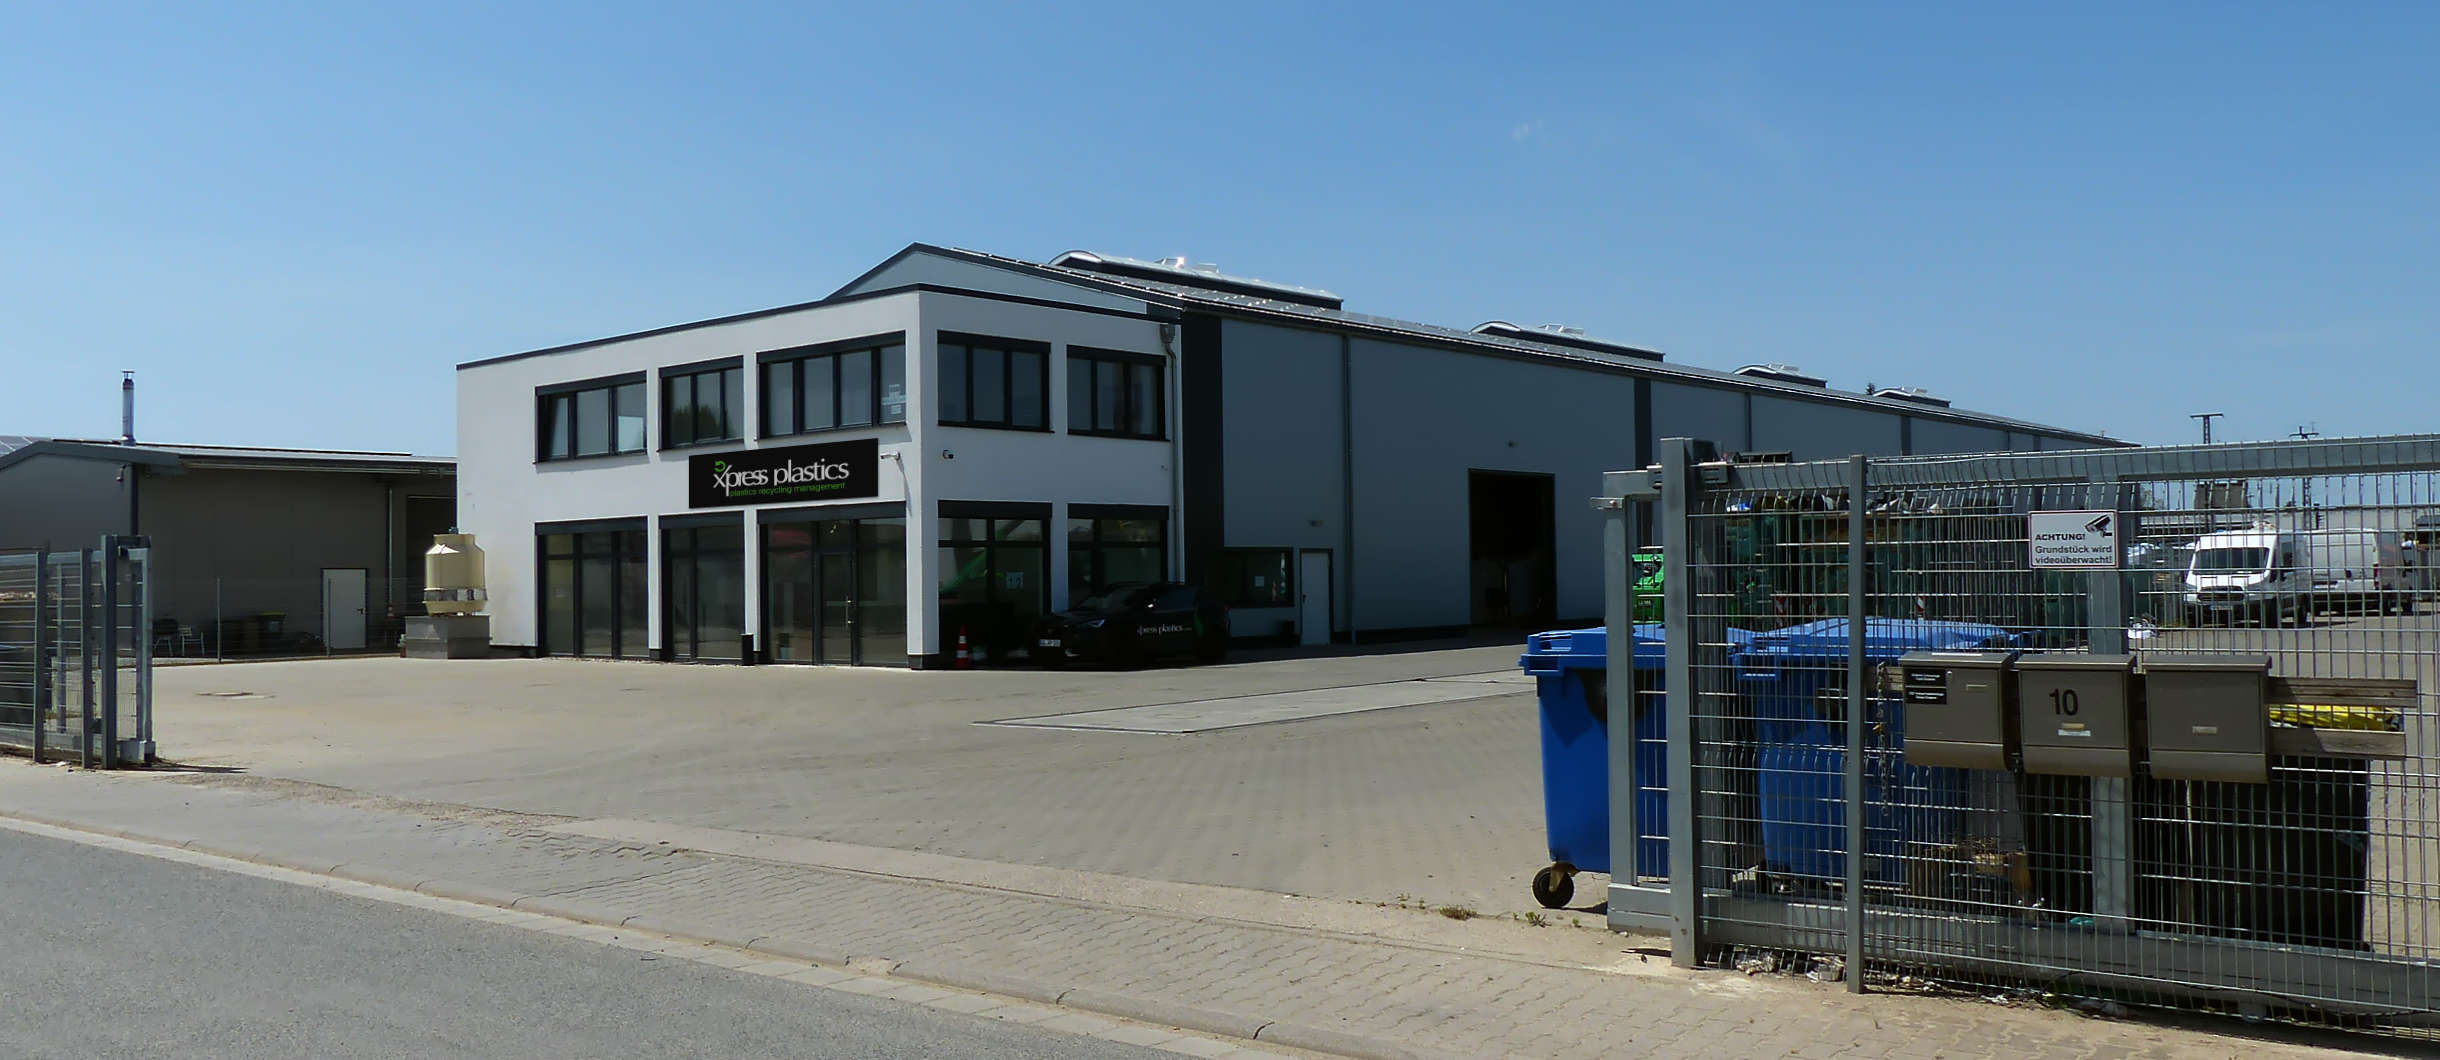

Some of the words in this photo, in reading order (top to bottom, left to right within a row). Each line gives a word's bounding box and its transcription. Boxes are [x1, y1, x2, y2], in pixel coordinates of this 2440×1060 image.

[773, 458, 850, 486] plastics
[729, 488, 757, 497] plastics
[758, 486, 792, 496] recycling
[793, 482, 846, 493] management
[2035, 545, 2089, 554] Grundstück
[2091, 545, 2112, 553] wird
[2035, 555, 2112, 564] videoüberwacht!
[2049, 688, 2079, 716] 10
